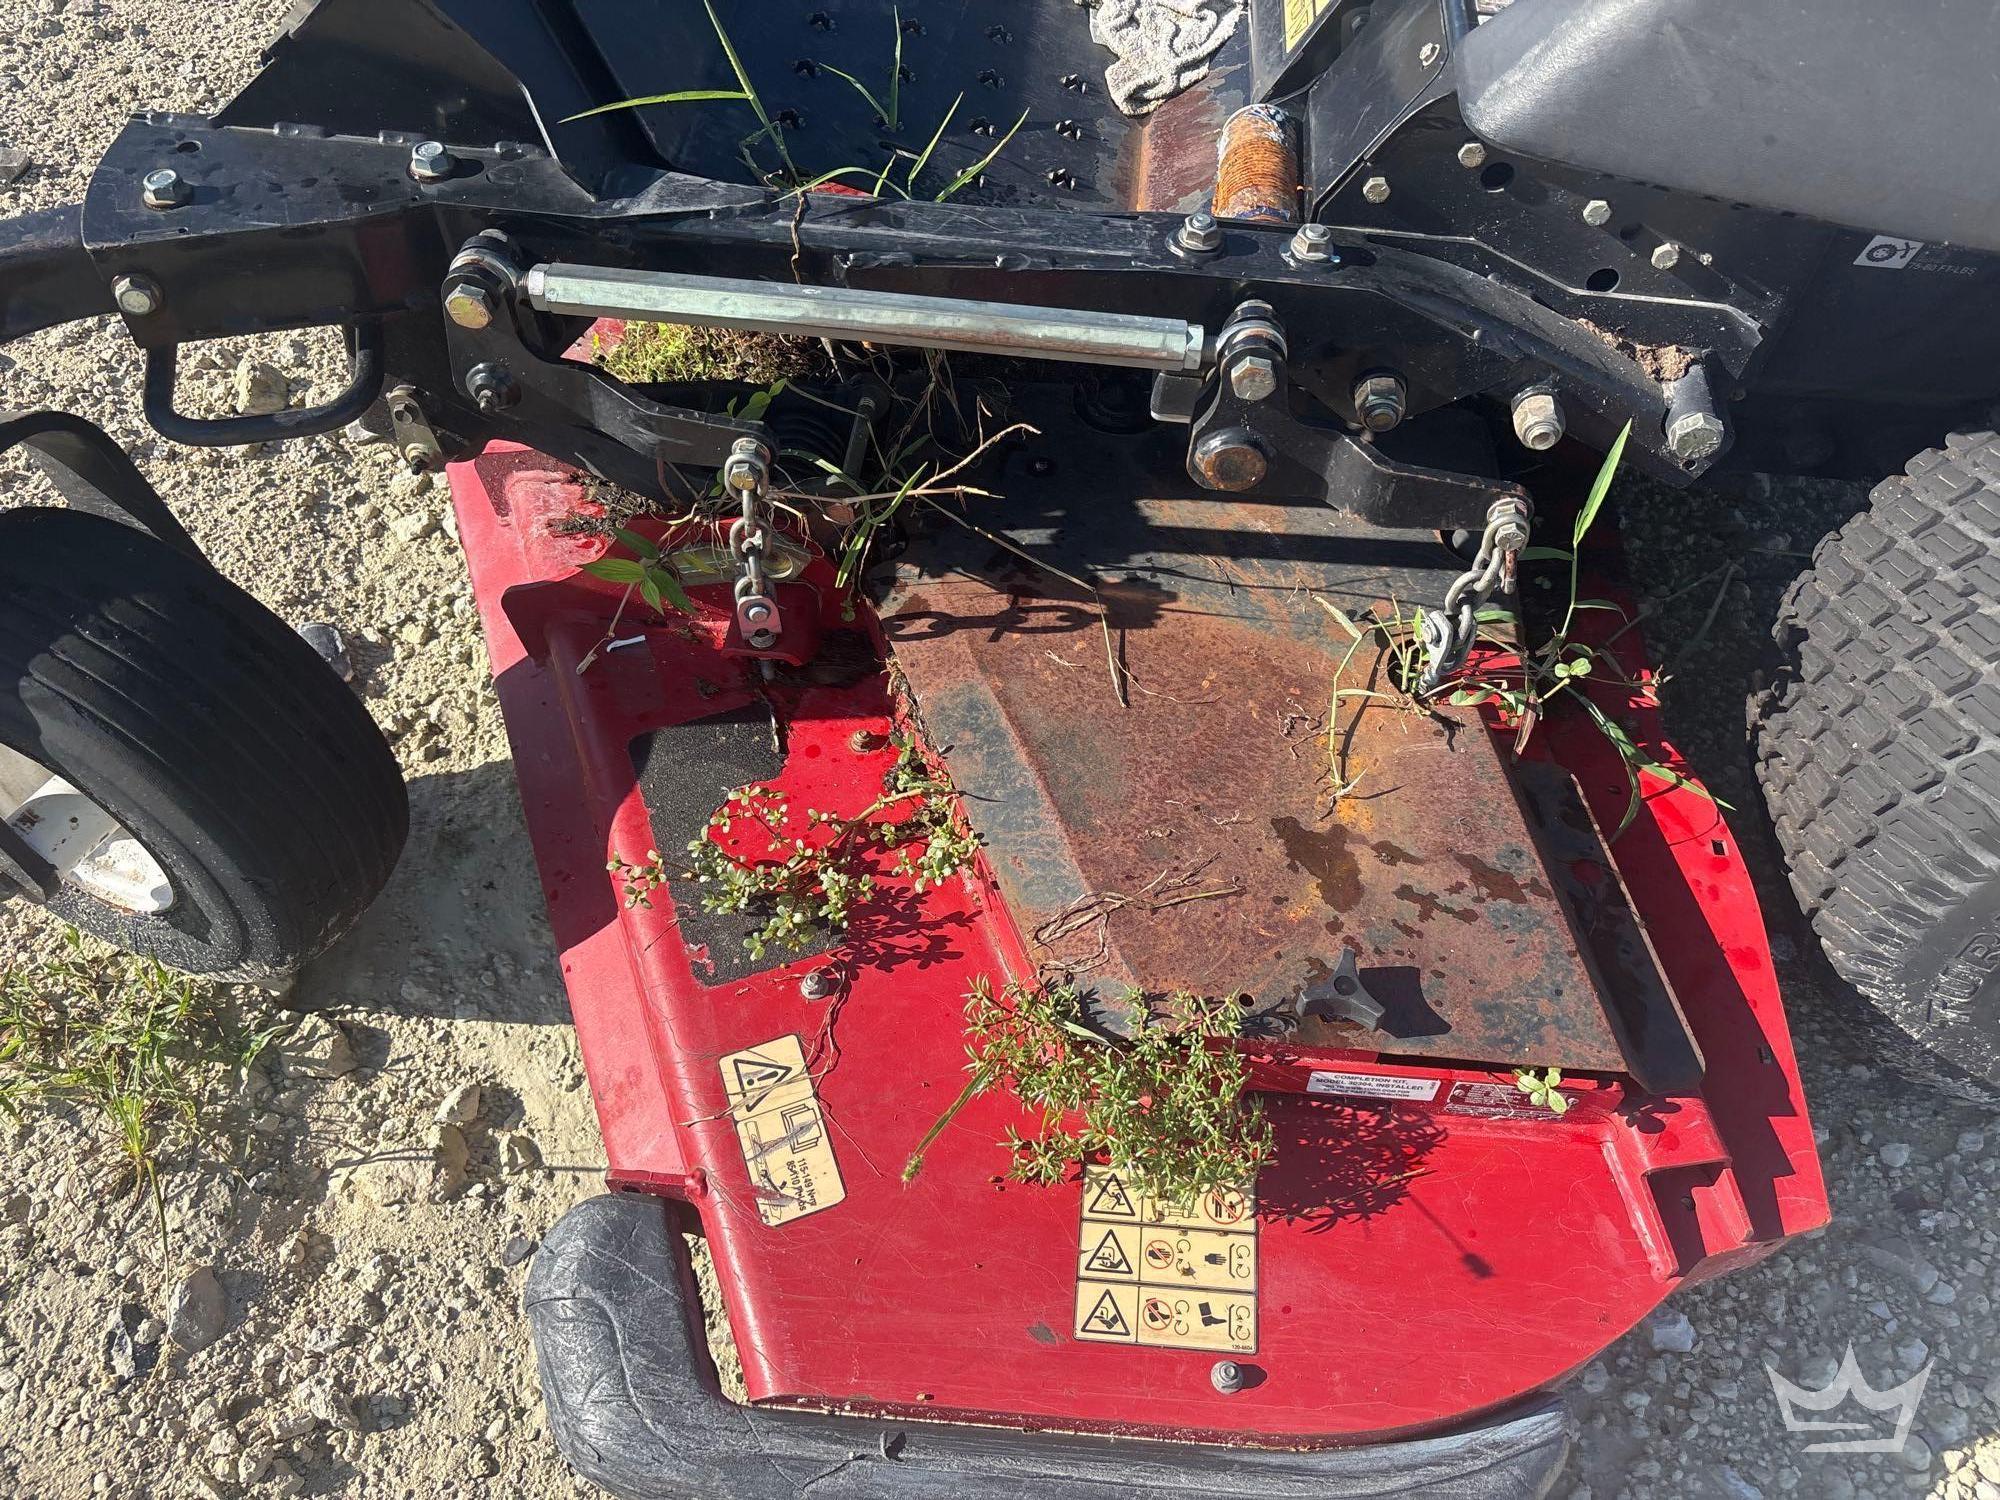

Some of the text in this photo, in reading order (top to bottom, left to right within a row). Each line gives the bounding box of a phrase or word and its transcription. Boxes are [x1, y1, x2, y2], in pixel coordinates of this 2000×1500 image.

[1925, 931, 2000, 1023] TUR
[1334, 1075, 1391, 1083] COMPLETION
[1375, 1082, 1423, 1090] INSTALLED
[798, 1158, 813, 1188] 115-149
